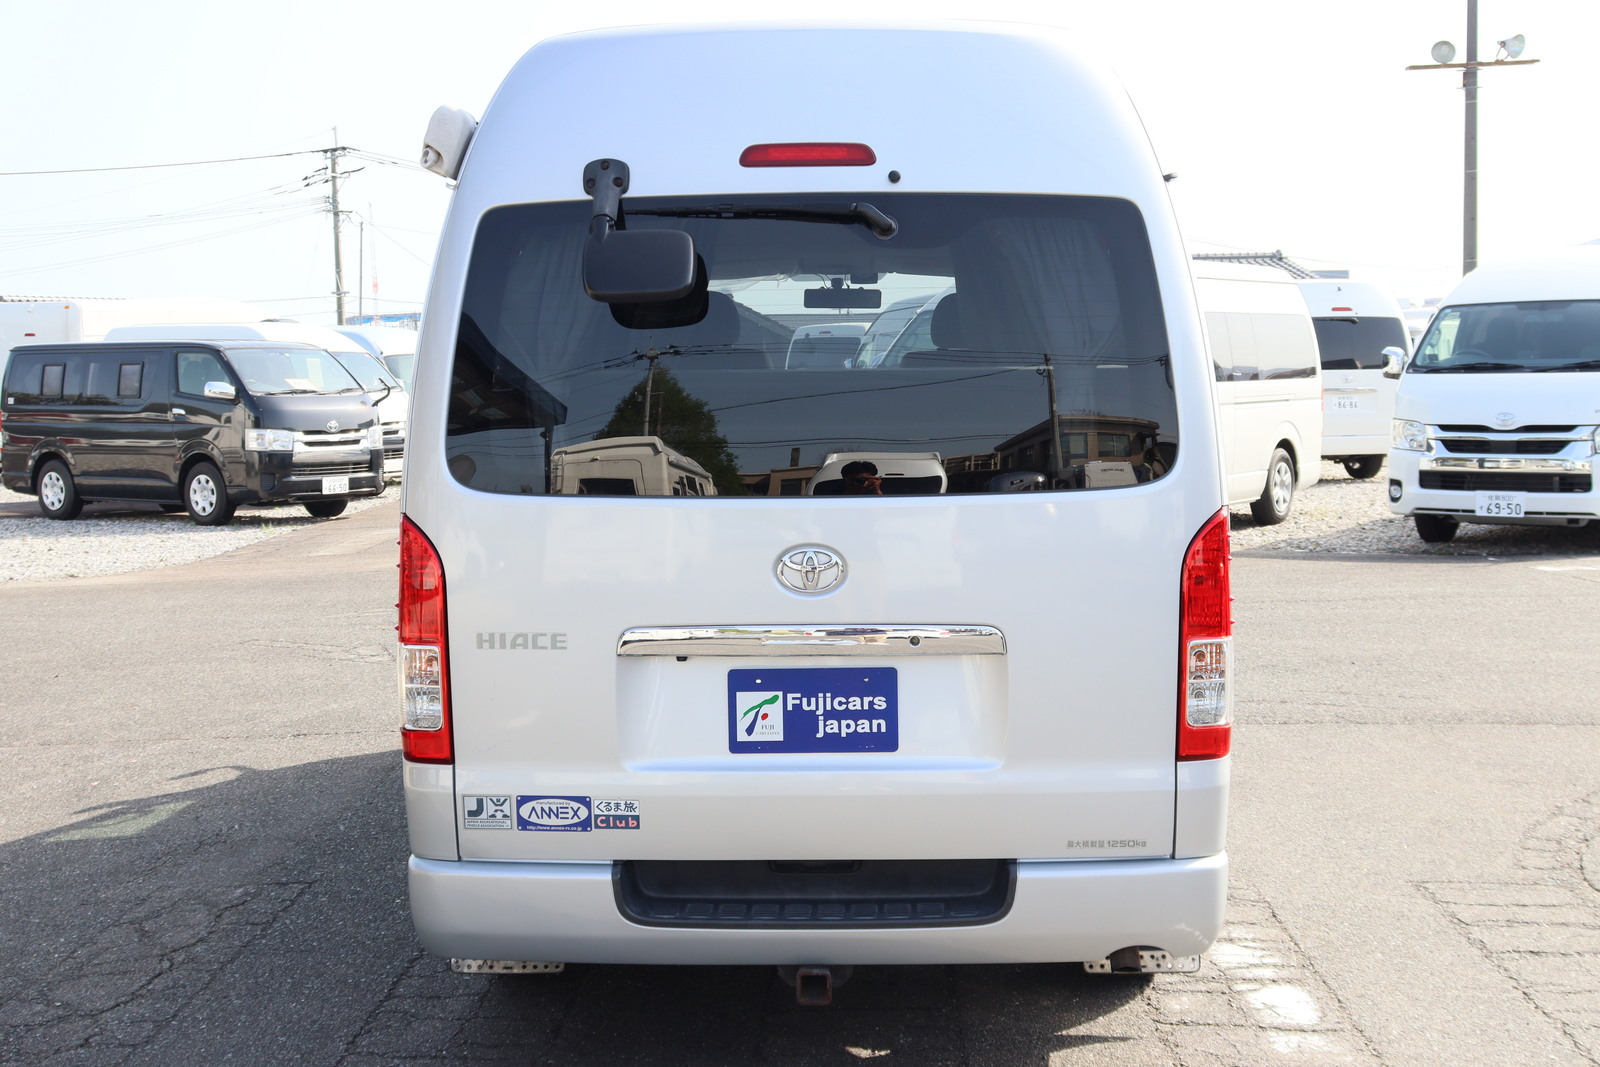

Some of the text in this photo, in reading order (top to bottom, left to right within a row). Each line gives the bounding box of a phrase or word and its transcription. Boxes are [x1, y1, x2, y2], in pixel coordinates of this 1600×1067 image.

[1486, 502, 1521, 515] 69-50
[476, 632, 568, 650] HIACE
[786, 693, 887, 715] Fujicars
[815, 715, 887, 738] japan
[527, 805, 582, 820] ANNEX
[595, 800, 638, 814] くるま旅
[596, 816, 638, 828] Club
